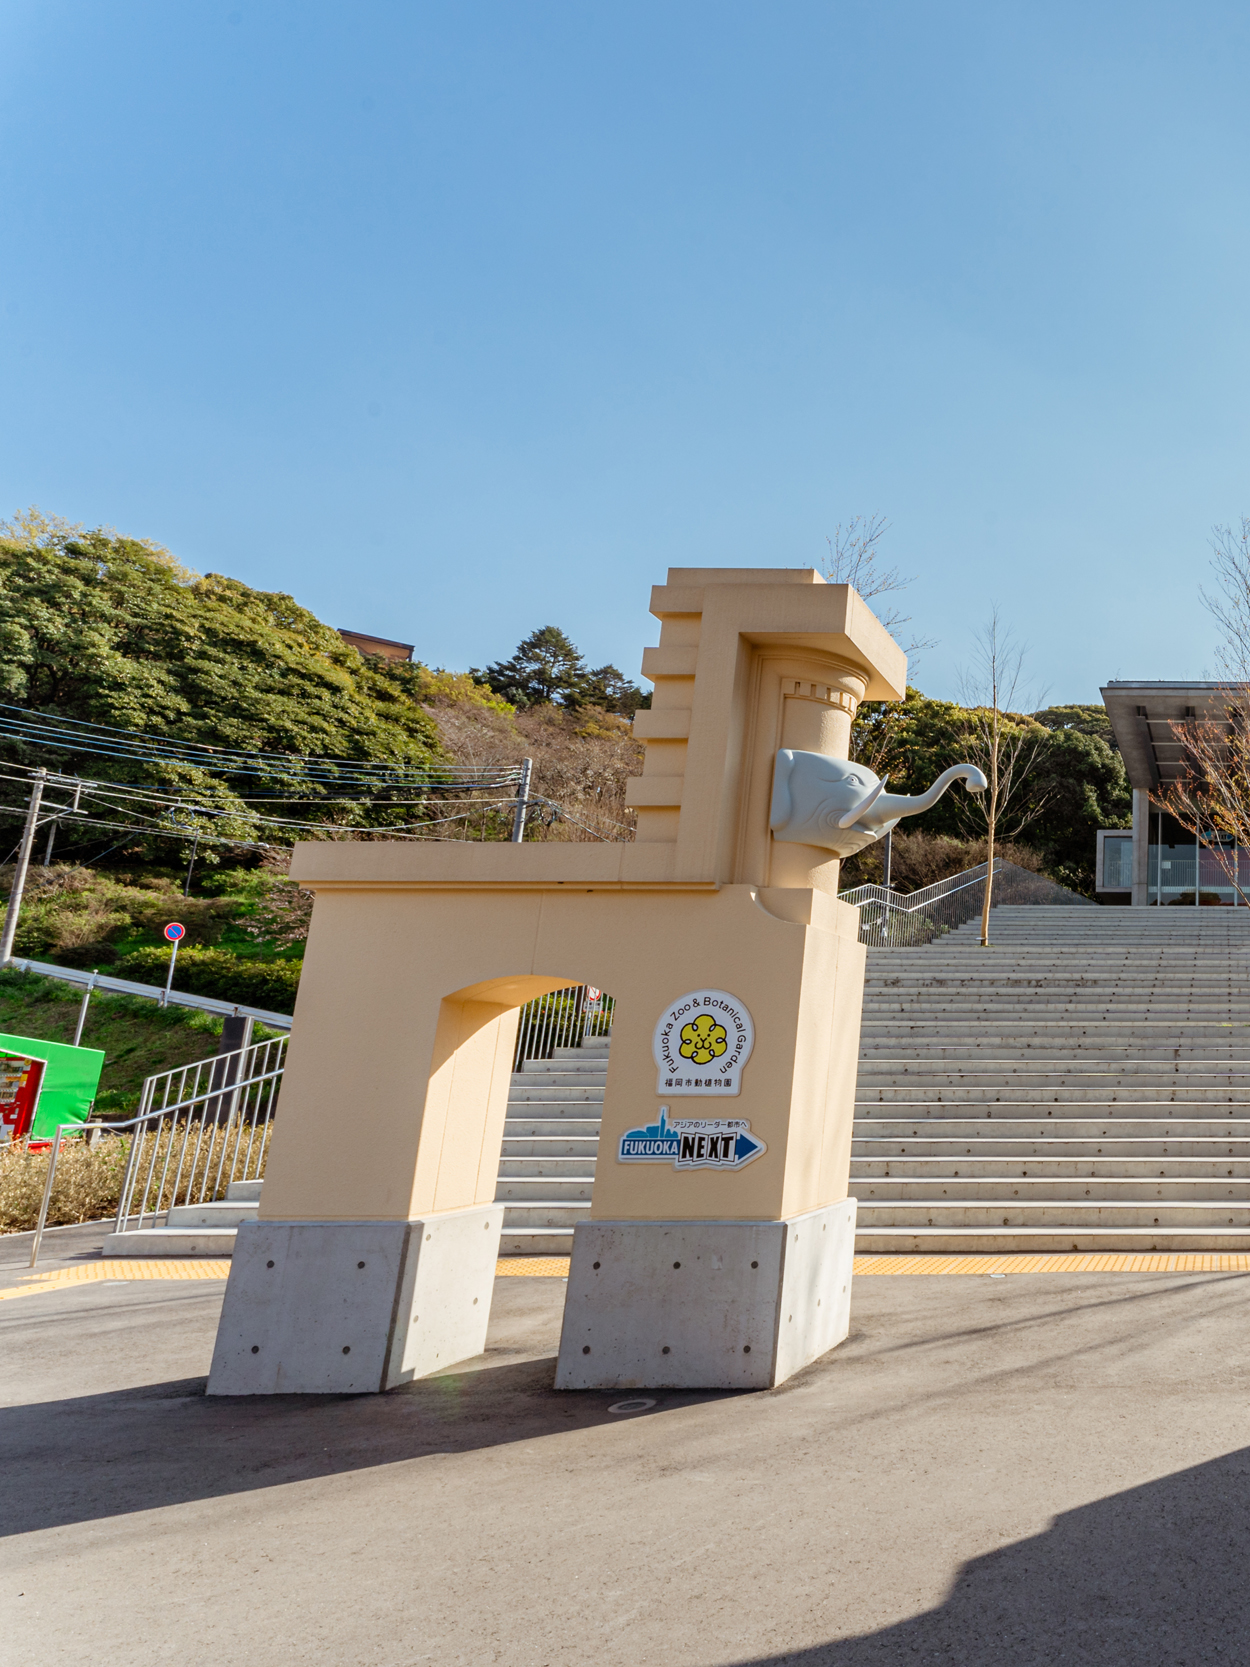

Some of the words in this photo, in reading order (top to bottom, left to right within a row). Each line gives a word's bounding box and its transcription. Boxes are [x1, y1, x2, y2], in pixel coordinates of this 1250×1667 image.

[670, 1004, 691, 1021] Zoo
[692, 998, 701, 1008] &
[703, 997, 746, 1033] Botanical
[661, 1022, 679, 1074] Fukuoka
[719, 1034, 747, 1074] Garden
[664, 1078, 732, 1088] 福岡市動植物園
[673, 1121, 748, 1129] アジアのリーダー都市へ
[623, 1141, 679, 1155] FUKUOKA
[680, 1134, 735, 1160] NEXT
